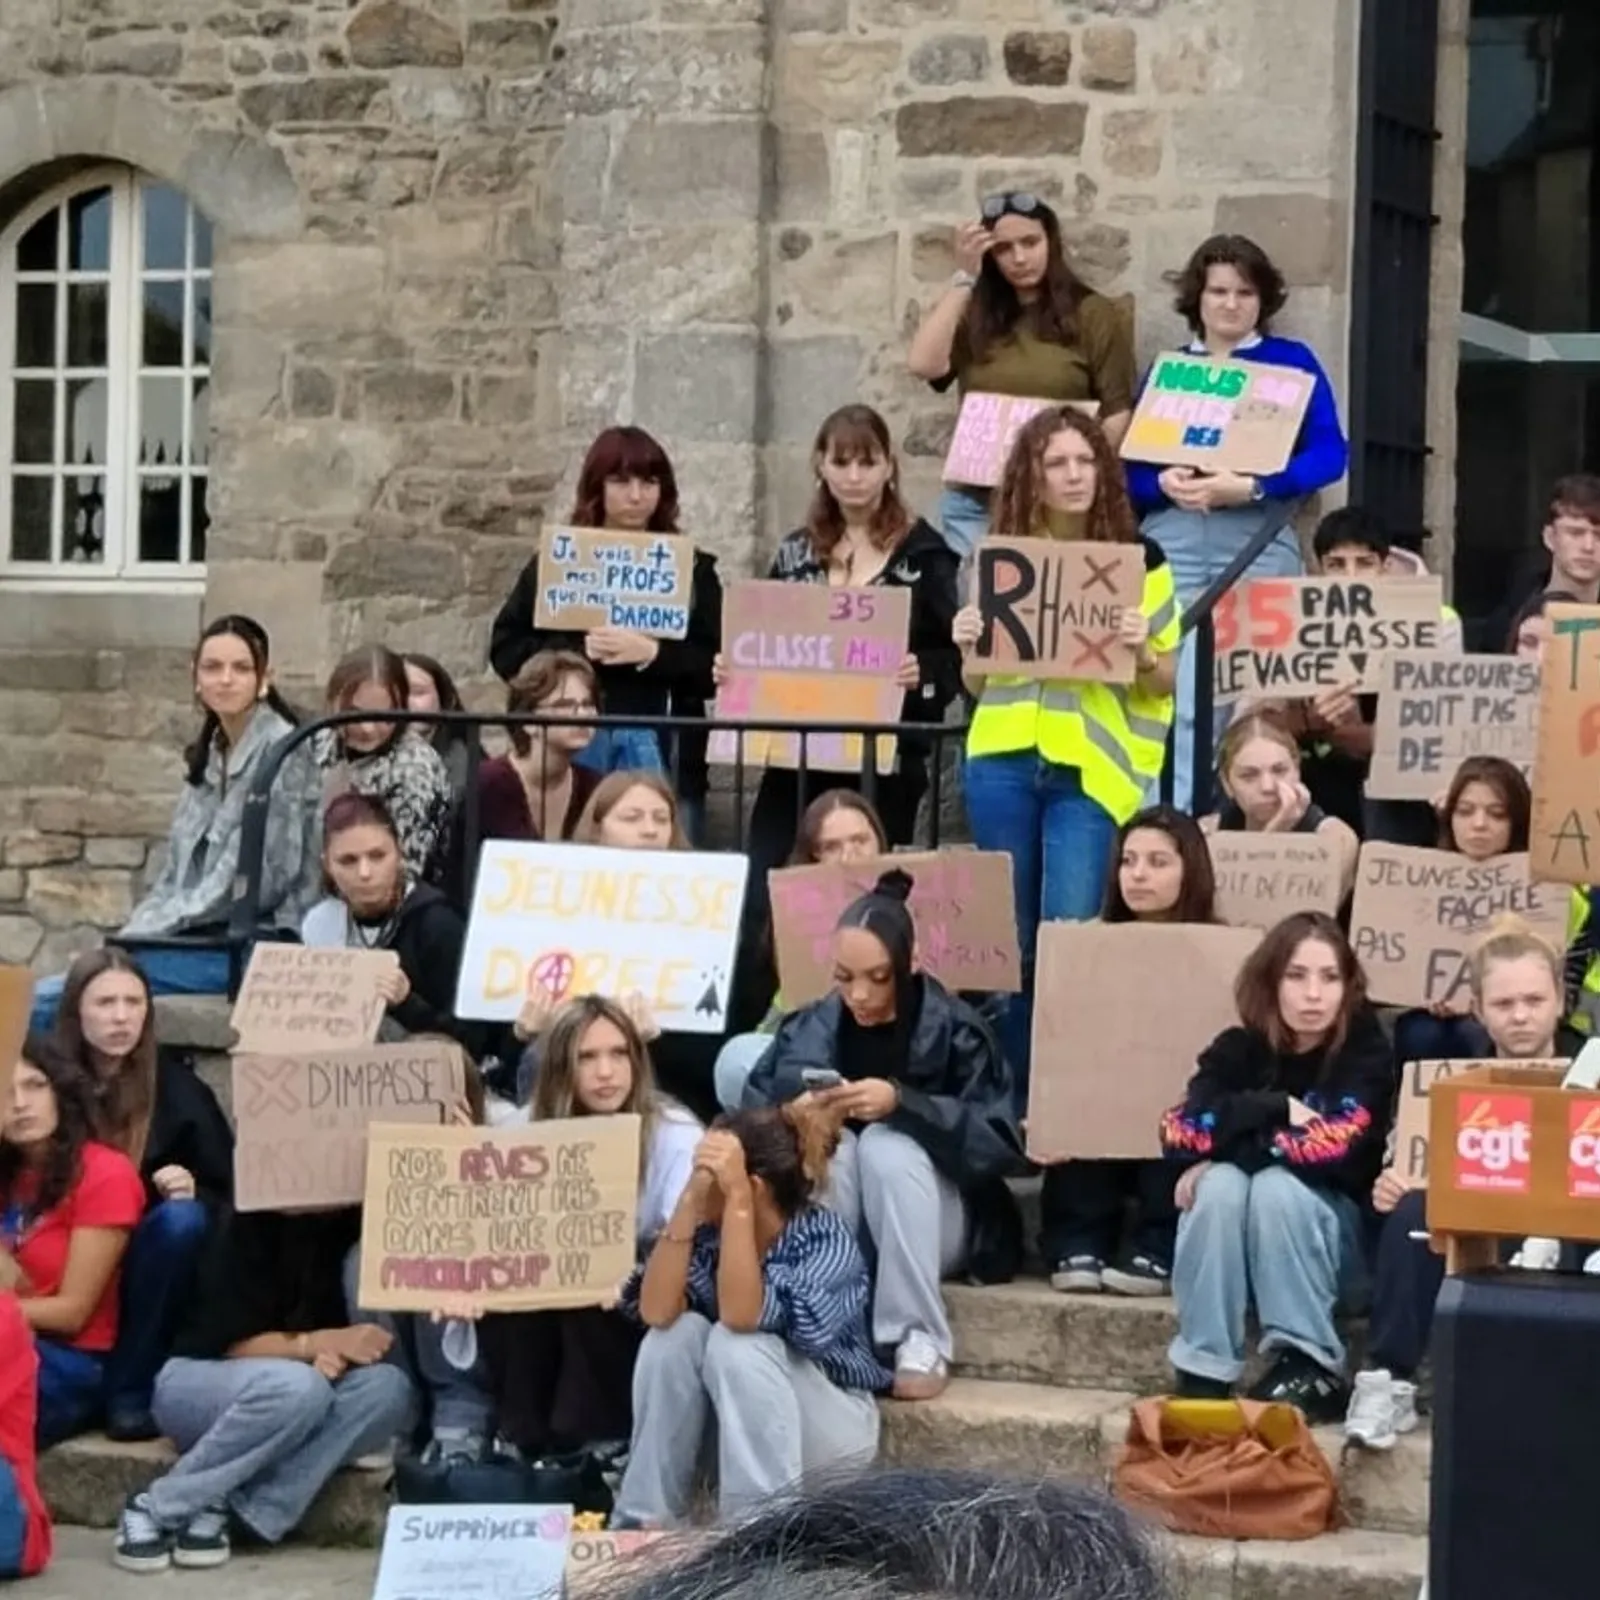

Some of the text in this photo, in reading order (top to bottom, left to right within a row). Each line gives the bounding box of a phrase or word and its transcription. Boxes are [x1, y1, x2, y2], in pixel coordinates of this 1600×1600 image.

[1155, 361, 1248, 398] NOUS
[552, 536, 577, 560] Je
[606, 564, 676, 594] PROFS
[611, 604, 685, 630] DARONS
[829, 592, 875, 622] 35
[1300, 583, 1376, 618] PAR
[732, 631, 834, 670] CLASSE
[1298, 619, 1438, 650] CLASSE
[1393, 659, 1542, 694] PARCOURS
[1399, 694, 1464, 727] DOIT
[1471, 697, 1517, 724] PAS
[1398, 737, 1443, 772] DE
[1366, 857, 1511, 892] JEUNESSE
[483, 857, 738, 932] JEUNESSE
[1351, 926, 1406, 962] PAS
[1457, 1121, 1532, 1171] cgt
[388, 1147, 447, 1181] NOS
[383, 1216, 476, 1253] DANS
[488, 1216, 547, 1252] UNE
